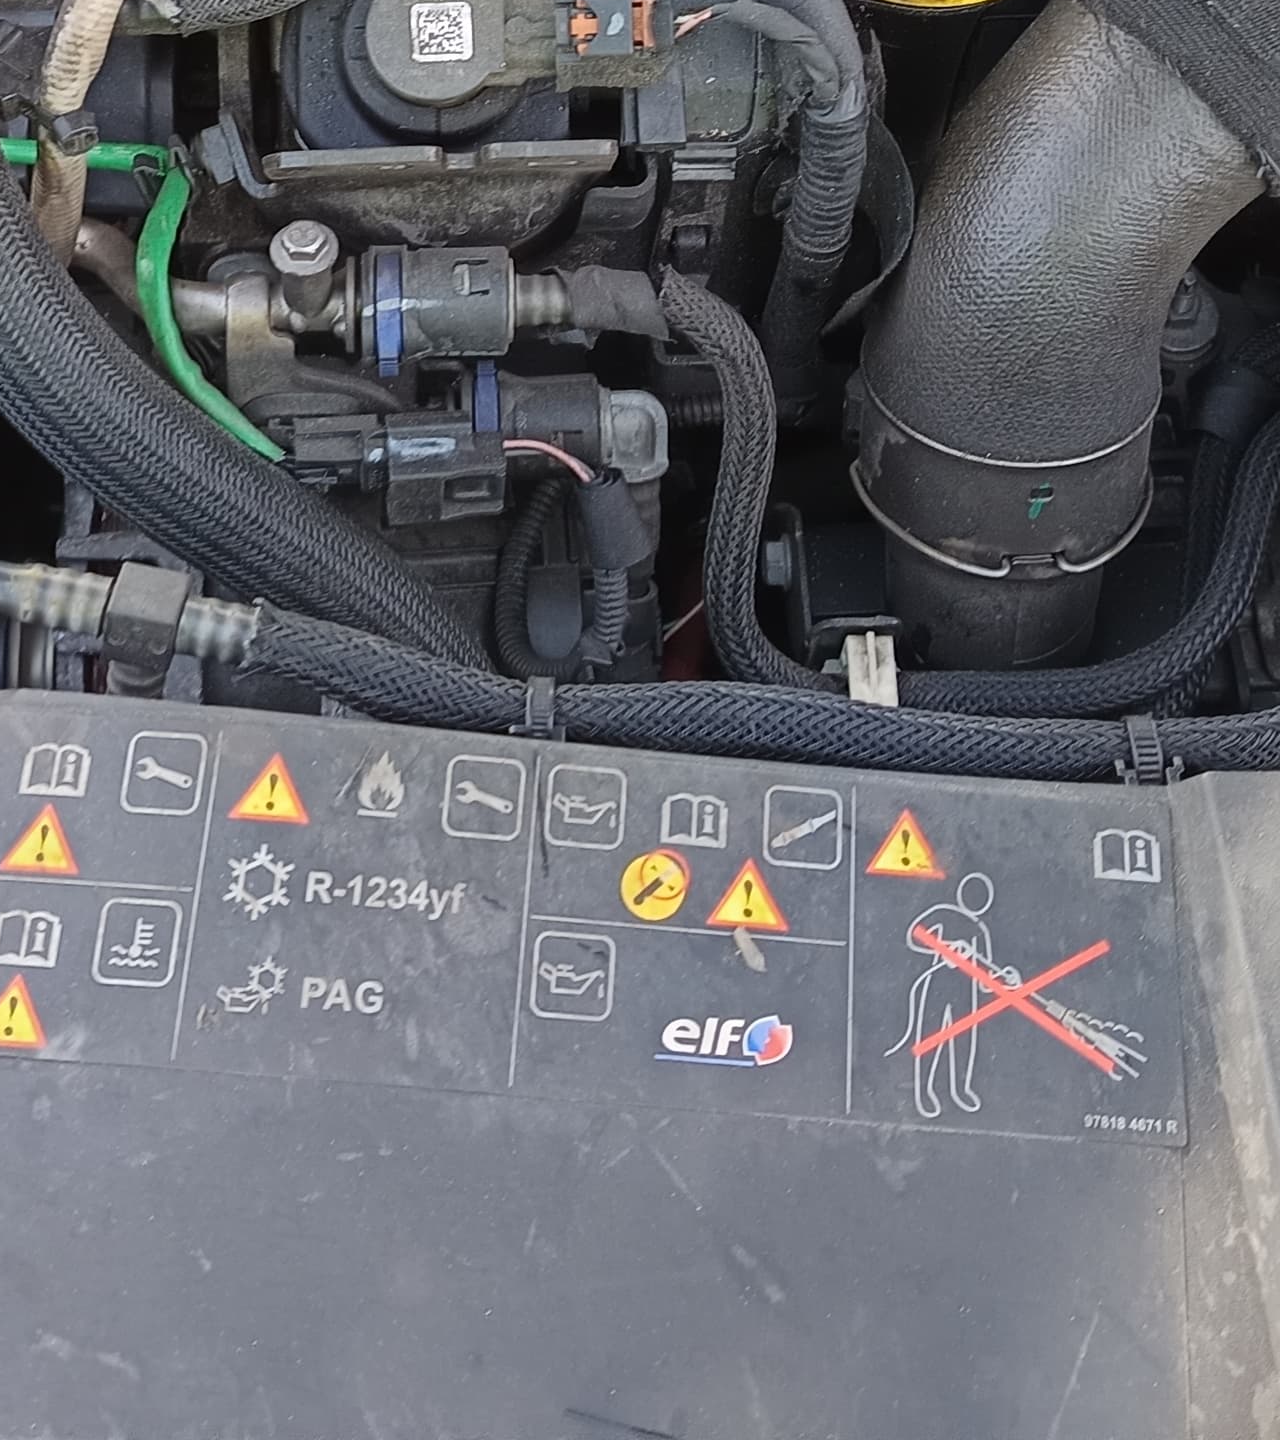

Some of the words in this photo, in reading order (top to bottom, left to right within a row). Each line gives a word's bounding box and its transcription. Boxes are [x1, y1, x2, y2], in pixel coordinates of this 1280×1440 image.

[304, 870, 467, 921] R-1234yf
[299, 976, 385, 1014] PAG
[661, 1017, 746, 1056] elf
[1166, 1119, 1178, 1134] R
